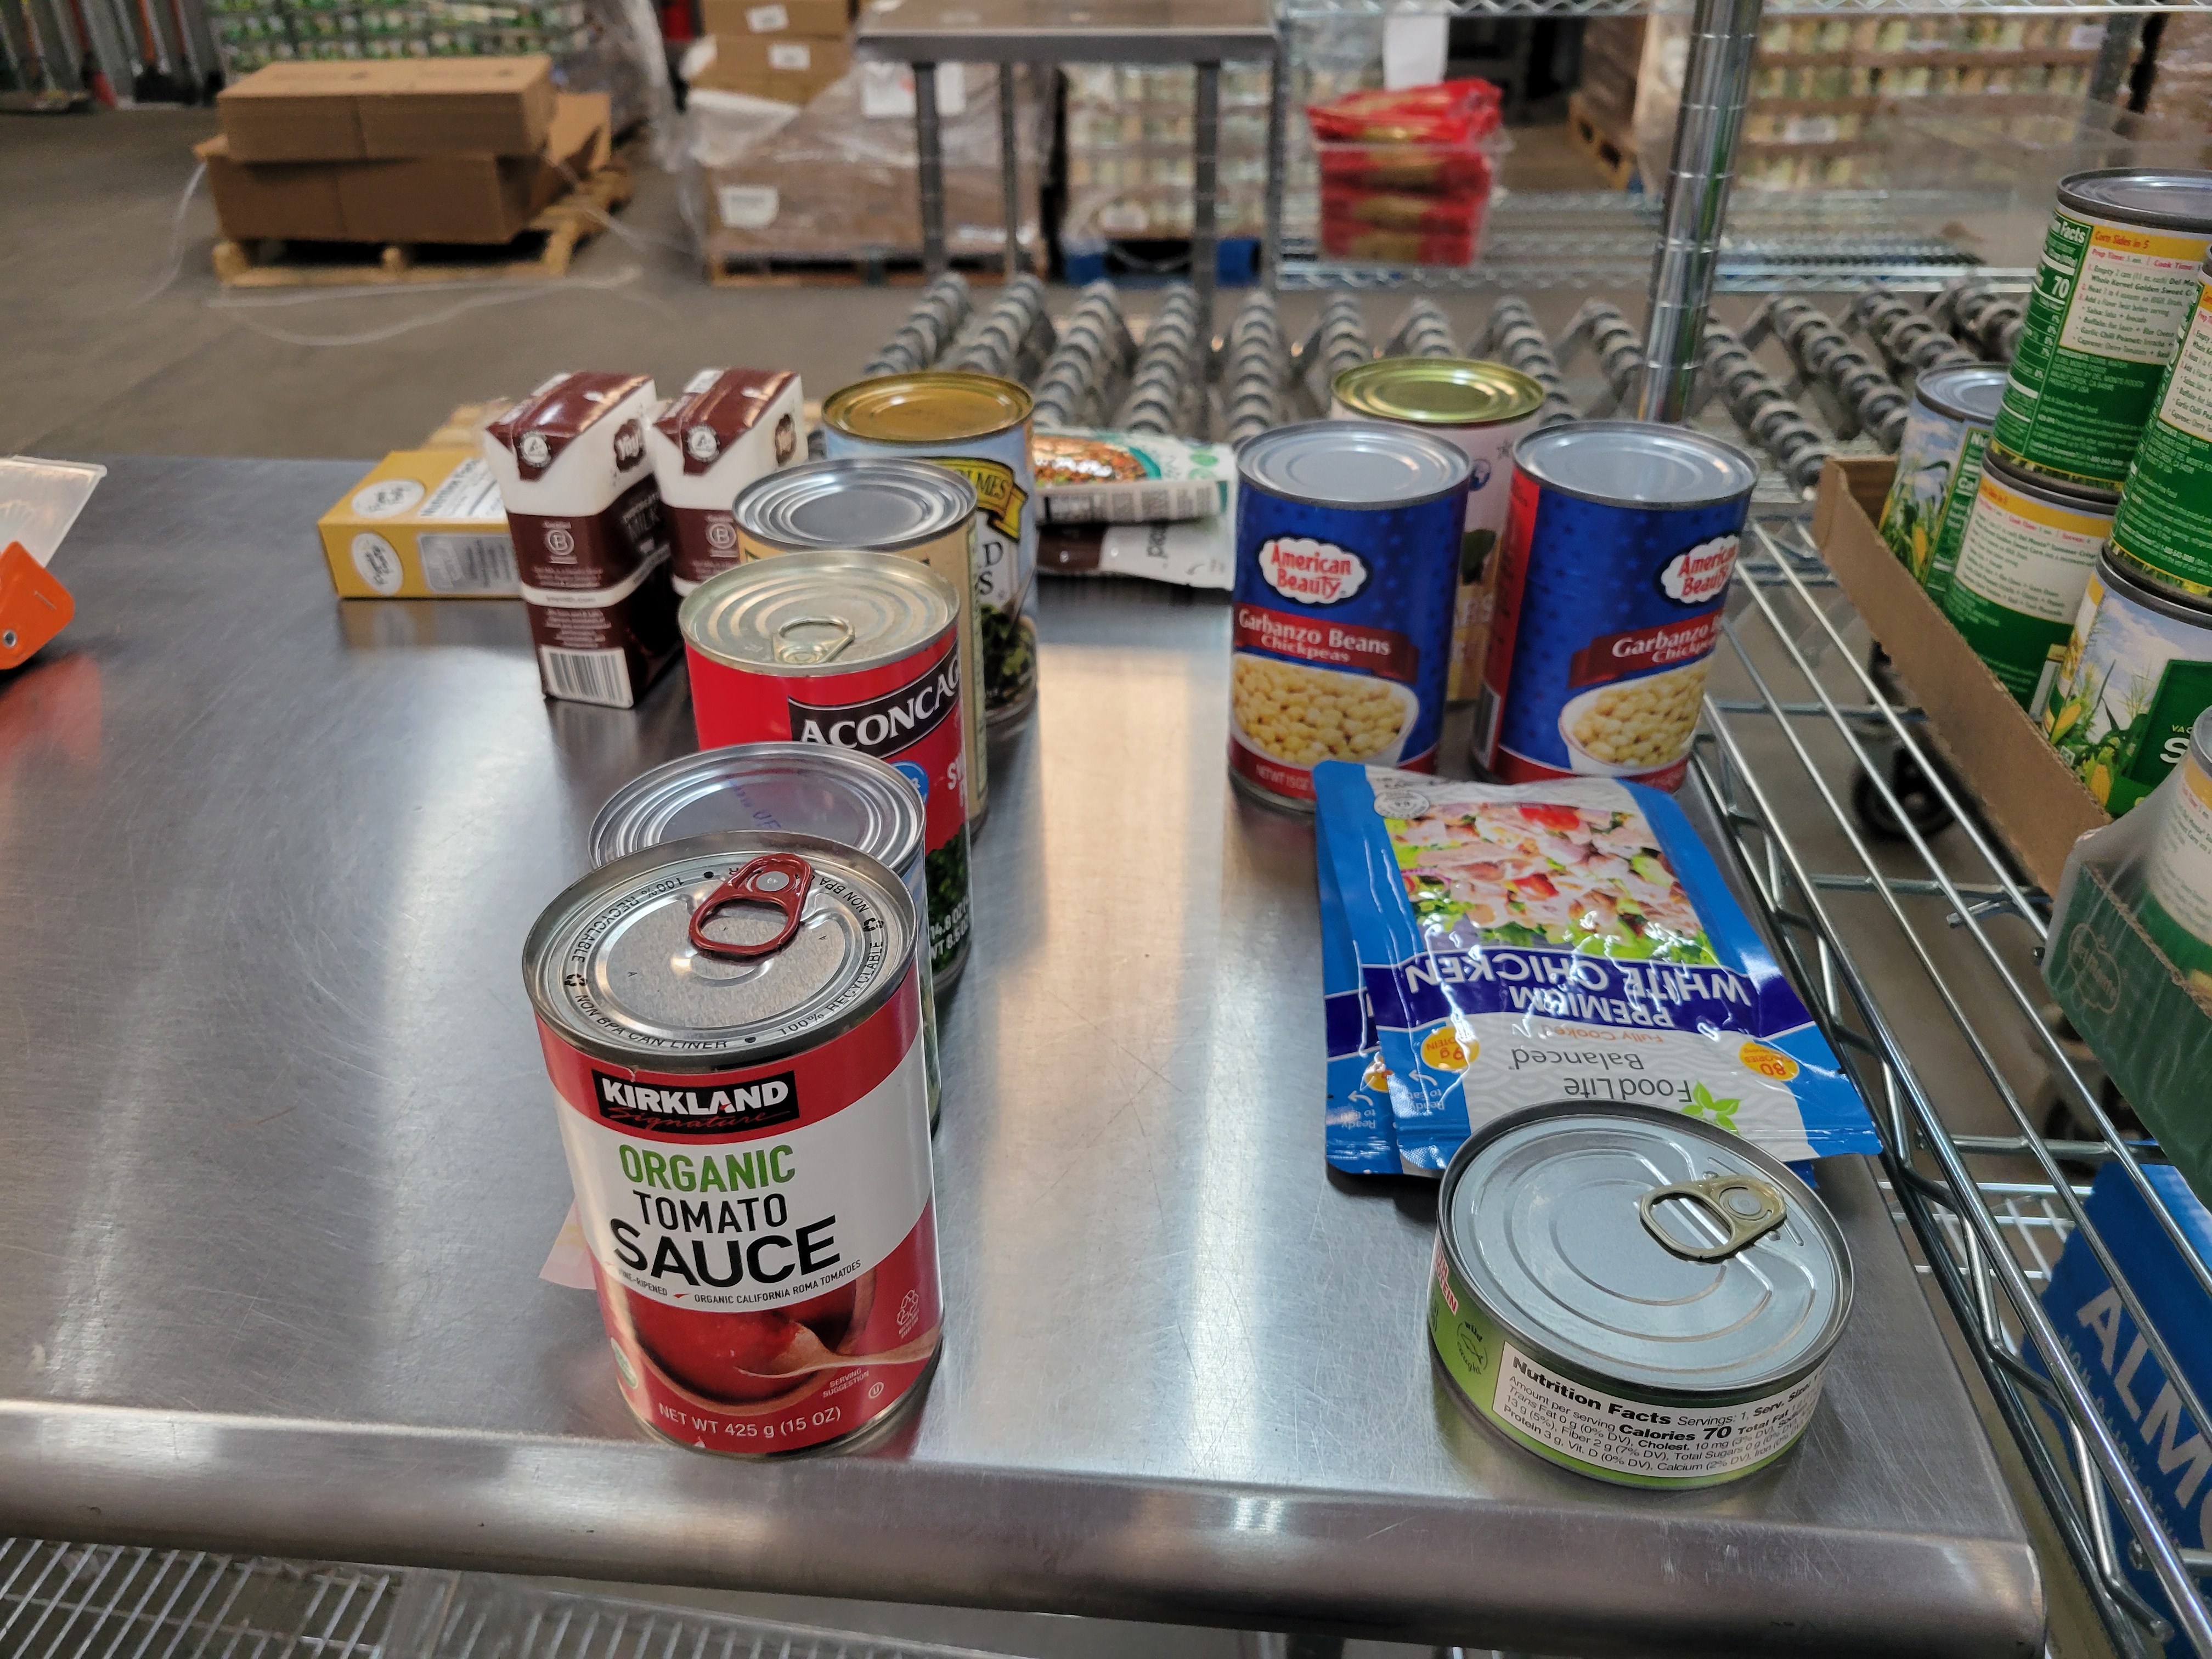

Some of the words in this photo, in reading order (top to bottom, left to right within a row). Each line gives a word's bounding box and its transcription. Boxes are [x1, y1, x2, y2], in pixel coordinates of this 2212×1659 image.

[2061, 221, 2085, 243] Facts
[2095, 230, 2111, 242] Corn
[2052, 275, 2070, 298] 70
[1271, 543, 1351, 575] American
[1277, 568, 1341, 599] Beauty
[1238, 608, 1322, 645] Garbanzo
[1328, 628, 1392, 656] Beans
[1261, 633, 1351, 663] Chickpeas
[1612, 624, 1709, 658] Garbanzo
[641, 877, 685, 898] 100%
[819, 878, 848, 895] BPA
[843, 891, 870, 913] NON
[571, 896, 640, 963] RECYCLABLE
[777, 1013, 825, 1035] 100%
[824, 941, 883, 1012] RECYCLABLE
[1405, 952, 1610, 994] CHICKEN
[1622, 964, 1752, 1007] WHITE
[575, 994, 601, 1017] NON
[596, 1017, 626, 1035] BPA
[629, 1032, 667, 1046] CAN
[670, 1040, 727, 1049] LINER
[1509, 985, 1676, 1028] PREMIUM
[1426, 1036, 1456, 1052] OTEIN
[1622, 1030, 1663, 1043] Fully
[1759, 1062, 1787, 1076] 80
[602, 1077, 789, 1115] KIRKLAND
[608, 1105, 791, 1130] Signature
[619, 1144, 795, 1193] ORGANIC
[633, 1189, 788, 1234] TOMATO
[610, 1214, 840, 1288] SAUCE
[694, 1293, 734, 1304] ORGANIC
[736, 1289, 791, 1303] CALIFORNIA
[793, 1280, 819, 1295] ROMA
[820, 1259, 862, 1286] TOMATOES
[822, 1370, 869, 1398] SUGGESTION
[830, 1368, 862, 1388] SERVING
[1513, 1356, 1601, 1410] Nutrition
[1607, 1402, 1671, 1425] Facts
[1678, 1414, 1736, 1426] Servings:
[1753, 1400, 1784, 1417] Serv.
[659, 1402, 687, 1425] NET
[691, 1417, 718, 1434] WT
[725, 1423, 757, 1437] 425
[764, 1425, 775, 1438] g
[781, 1417, 807, 1436] (15
[812, 1406, 841, 1426] OZ)
[1509, 1375, 1549, 1404] Amount
[1551, 1402, 1571, 1414] per
[1572, 1410, 1616, 1432] serving
[1619, 1424, 1696, 1441] Calories
[1703, 1425, 1732, 1440] 70
[1737, 1419, 1770, 1435] Total
[1771, 1409, 1789, 1423] Fat
[1509, 1385, 1537, 1409] Trans
[1538, 1403, 1557, 1419] Fat
[1559, 1415, 1567, 1424] 0
[1569, 1420, 1577, 1430] g
[1581, 1423, 1604, 1437] (0%
[1638, 1440, 1690, 1451] Cholest.
[1695, 1442, 1708, 1451] 10
[1711, 1441, 1729, 1449] mg
[1732, 1435, 1752, 1447] (3%
[1504, 1404, 1542, 1434] Protein
[1544, 1430, 1551, 1439] 3
[1568, 1440, 1584, 1454] Vit.
[1588, 1448, 1598, 1458] D
[1601, 1453, 1624, 1465] (0%
[1657, 1462, 1703, 1471] Calcium
[1706, 1460, 1728, 1470] (2%
[1507, 1395, 1518, 1408] 13
[1520, 1406, 1527, 1415] g
[1561, 1425, 1591, 1443] Fiber
[1593, 1438, 1601, 1447] 2
[1604, 1443, 1612, 1452] g
[1616, 1444, 1639, 1457] (7%
[1675, 1452, 1702, 1460] Total
[1705, 1446, 1743, 1459] Sugars
[1754, 1441, 1760, 1449] g
